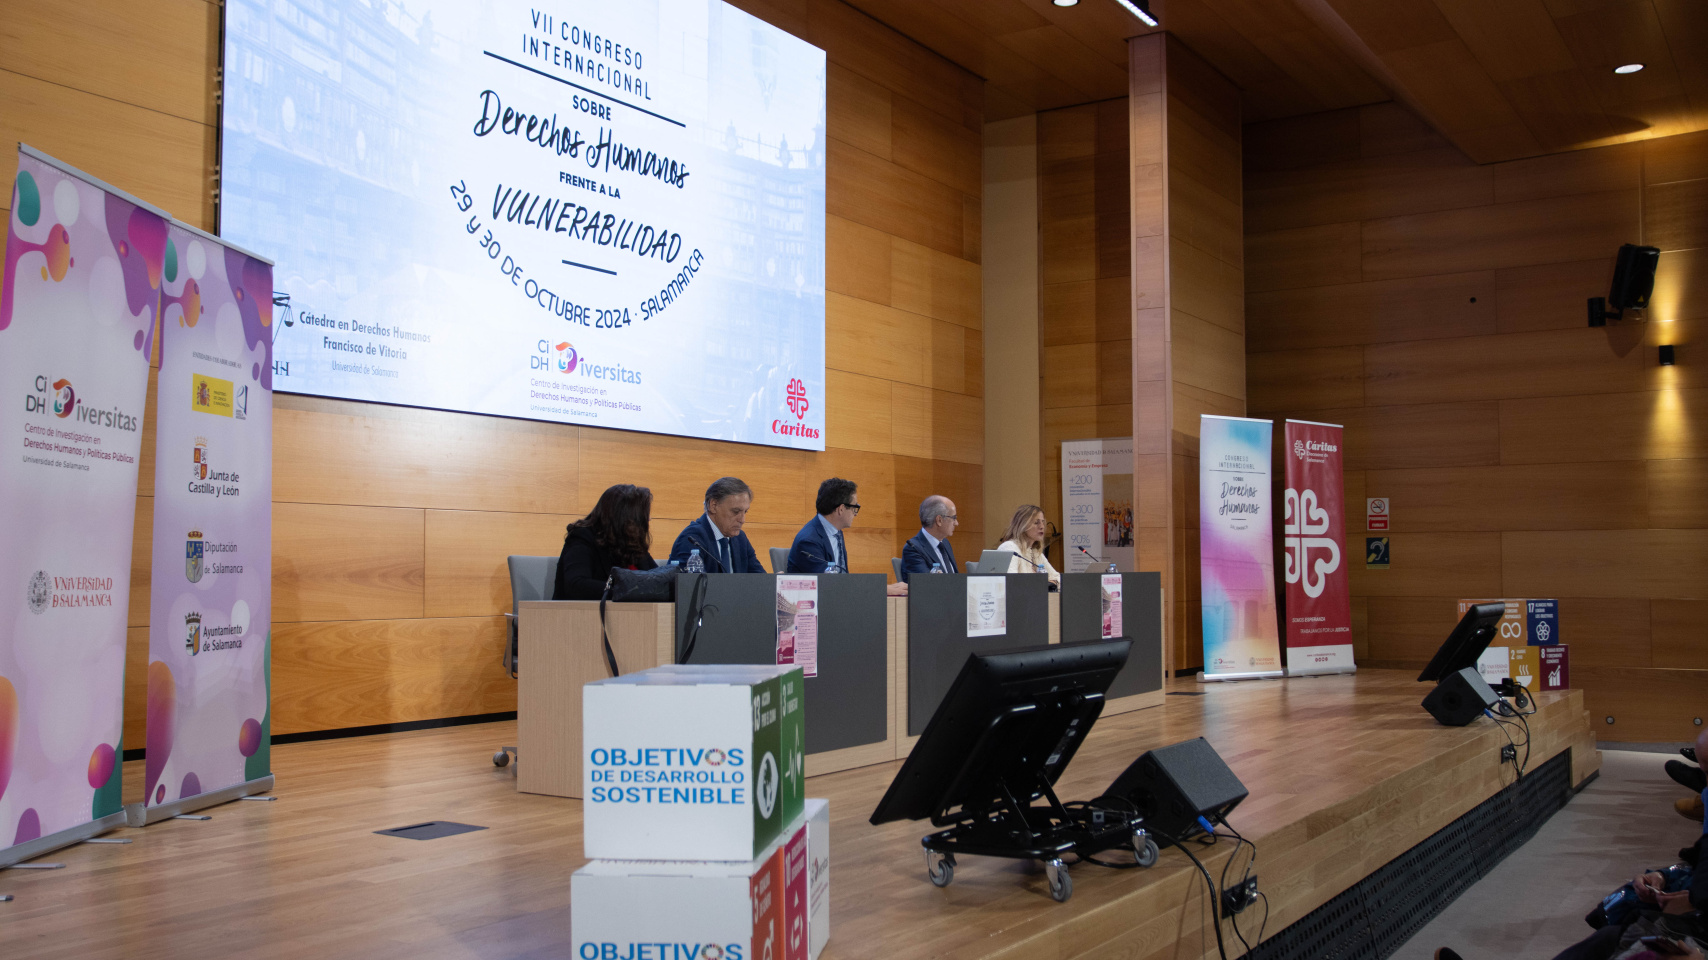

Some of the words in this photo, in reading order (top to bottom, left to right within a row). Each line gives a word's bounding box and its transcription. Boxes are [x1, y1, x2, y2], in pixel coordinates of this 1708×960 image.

[531, 8, 553, 35] VII
[561, 22, 643, 70] CONGRESO
[523, 33, 651, 100] INTERNACIONAL
[572, 95, 612, 121] SOBRE
[473, 89, 585, 159] Derechos
[586, 126, 690, 189] Humanos
[559, 171, 597, 194] FRENTE
[599, 183, 607, 195] A
[608, 186, 621, 199] LA
[492, 183, 681, 263] VULNERABILIDAD
[449, 180, 473, 212] 29
[466, 215, 481, 234] y
[479, 229, 501, 260] 30
[500, 255, 523, 287] DE
[524, 278, 591, 327] OCTUBRE
[595, 307, 632, 329] 2024
[639, 248, 705, 321] SALAMANCA
[299, 311, 336, 329] Cátedra
[338, 321, 349, 331] en
[352, 320, 391, 337] Derechos
[393, 327, 432, 343] Humanos
[323, 336, 363, 354] Francisco
[366, 343, 377, 355] de
[378, 345, 407, 360] Vitoria
[331, 360, 362, 375] Universidad
[363, 364, 371, 375] de
[371, 365, 399, 378] Salamanca
[530, 355, 549, 371] DH
[530, 378, 551, 388] Centro
[552, 381, 560, 390] de
[561, 383, 599, 395] Investigación
[26, 394, 46, 414] DH
[530, 390, 559, 401] Derechos
[560, 394, 588, 404] Humanos
[594, 398, 618, 409] Políticas
[618, 401, 642, 411] Públicas
[530, 404, 561, 413] Universidad
[570, 409, 597, 418] Salamanca
[25, 423, 45, 435] Centro
[47, 427, 54, 437] de
[56, 429, 92, 443] Investigación
[772, 419, 819, 439] Cáritas
[24, 437, 53, 451] Derechos
[54, 443, 82, 456] Humanos
[82, 449, 87, 458] y
[87, 448, 111, 460] Políticas
[112, 452, 134, 464] Públicas
[1306, 440, 1337, 452] Cáritas
[23, 455, 54, 466] Universidad
[63, 460, 90, 471] Salamanca
[209, 470, 229, 481] Junta
[231, 472, 239, 482] de
[1070, 474, 1092, 484] +200
[188, 482, 215, 494] Castilla
[216, 486, 221, 498] y
[223, 485, 239, 496] León
[1221, 481, 1258, 499] Derechos
[1070, 504, 1093, 514] +300
[1219, 499, 1260, 516] Humanos
[205, 541, 237, 555] Diputación
[1071, 534, 1090, 544] 90%
[204, 565, 210, 574] de
[213, 563, 243, 574] Salamanca
[1459, 603, 1466, 612] 11
[1528, 603, 1534, 613] 17
[203, 624, 242, 639] Ayuntamiento
[203, 641, 210, 651] de
[212, 639, 242, 651] Salamanca
[1541, 648, 1545, 658] 8
[1511, 650, 1515, 660] 2
[783, 684, 787, 717] 3
[753, 694, 760, 732] 13
[590, 748, 745, 767] OBJETIVOS
[591, 770, 615, 783] DE
[620, 770, 745, 784] DESARROLLO
[591, 786, 745, 804] SOSTENIBLE
[754, 885, 758, 924] 5
[579, 942, 743, 960] OBJETIVOS
